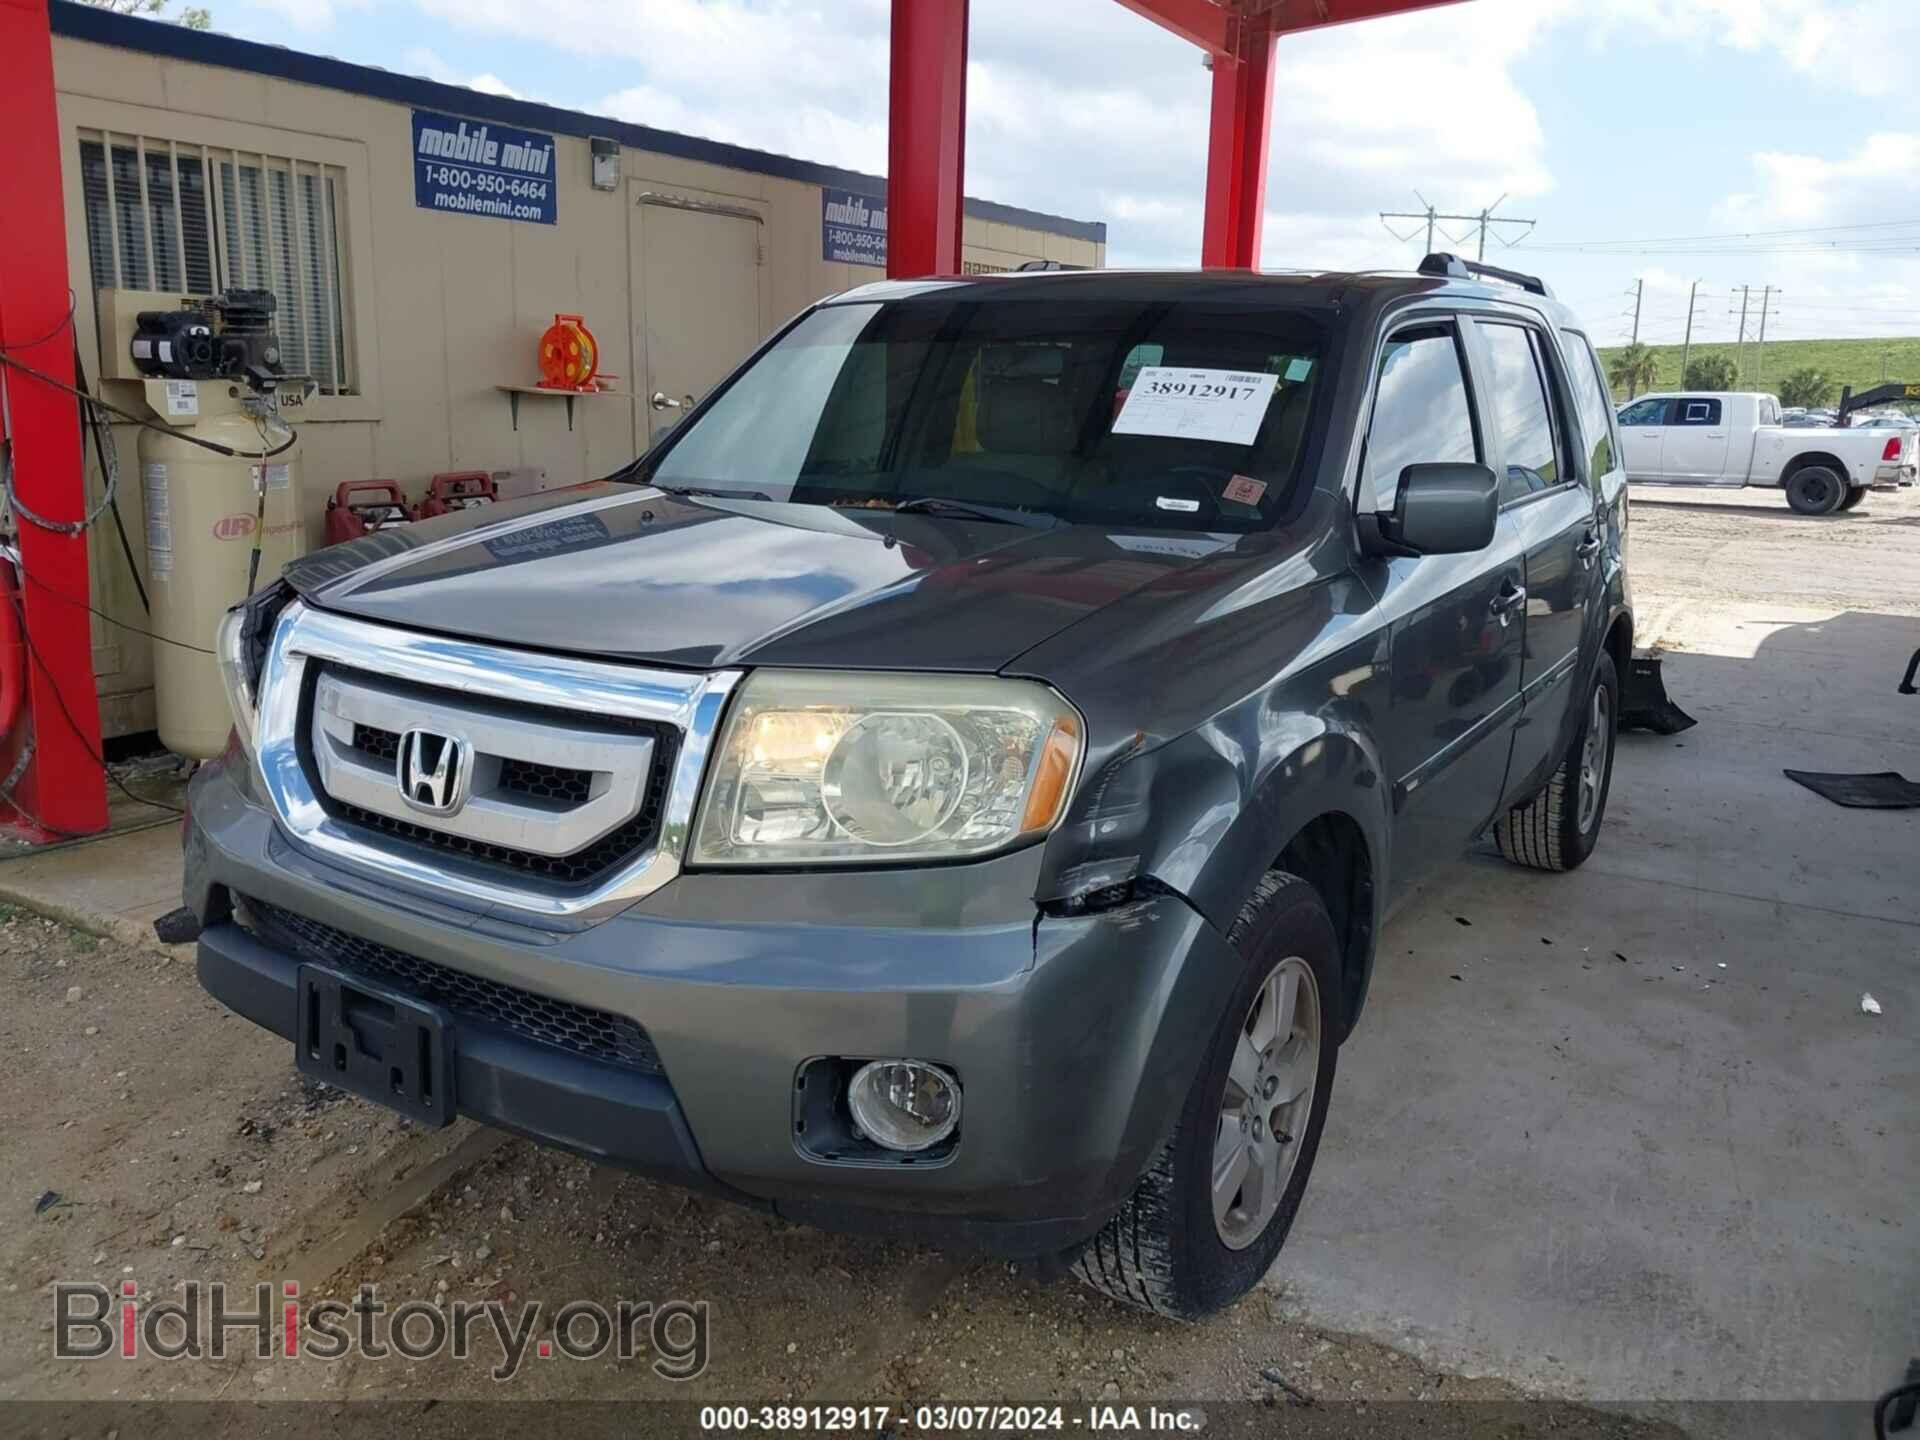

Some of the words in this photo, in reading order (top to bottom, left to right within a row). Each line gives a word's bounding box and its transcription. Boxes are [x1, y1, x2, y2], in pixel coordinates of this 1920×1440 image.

[418, 122, 498, 166] mobile
[500, 141, 550, 175] mini
[425, 165, 547, 200] 1-800-950-6464
[434, 192, 542, 220] mobilemini.com
[825, 196, 870, 228] mobile
[280, 394, 304, 407] USA
[1144, 381, 1256, 401] 38912917
